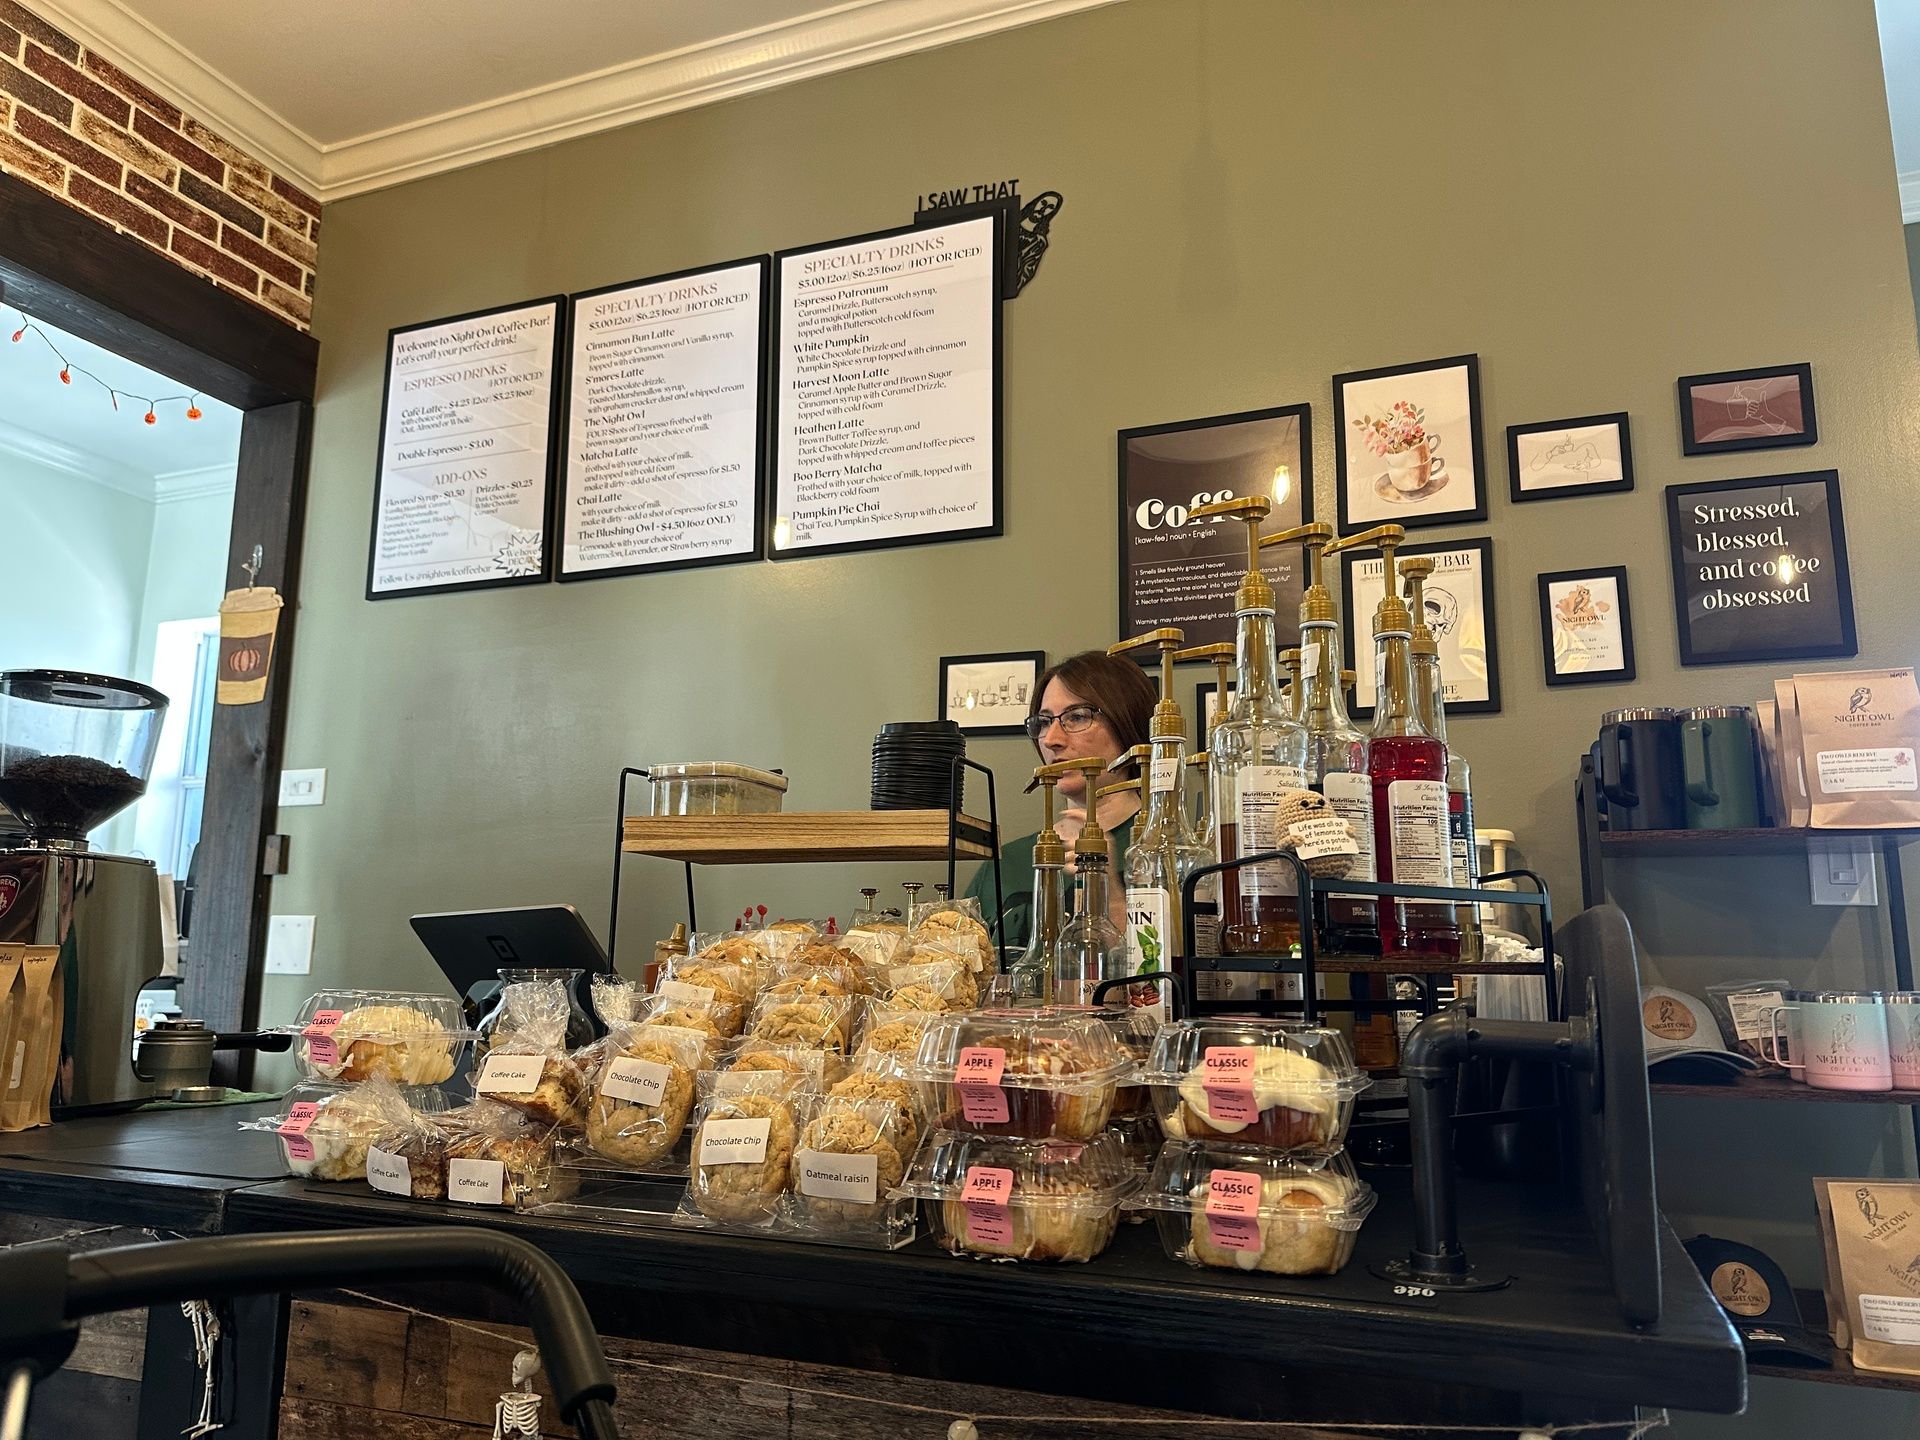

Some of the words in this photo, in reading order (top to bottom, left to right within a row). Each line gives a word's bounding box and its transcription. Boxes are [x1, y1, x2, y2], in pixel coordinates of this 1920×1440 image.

[918, 195, 922, 212] I
[928, 187, 968, 211] SAW
[972, 179, 1020, 202] THAT
[804, 249, 885, 274] SPECIALTY
[889, 236, 944, 258] DRINKS
[936, 252, 952, 263] OR
[594, 292, 666, 317] SPECIALTY
[668, 282, 717, 302] DRINKS
[794, 294, 836, 308] Espresso
[838, 284, 888, 300] Patronum
[798, 304, 831, 318] Caramel
[861, 290, 911, 306] Butterscotch
[397, 339, 438, 354] Welcome
[439, 337, 449, 345] to
[450, 330, 475, 344] Night
[476, 325, 496, 338] Owl
[496, 320, 528, 334] Coffee
[529, 315, 550, 328] Bar!
[585, 337, 630, 351] Cinnamon
[631, 334, 650, 343] Bun
[651, 328, 675, 340] Latte
[437, 347, 458, 359] your
[458, 340, 490, 356] perfect
[793, 342, 823, 353] White
[825, 333, 869, 354] Pumpkin
[404, 371, 462, 392] ESPRESSO
[463, 363, 507, 381] DRINKS
[620, 368, 644, 378] Latte
[792, 376, 830, 390] Harvest
[832, 372, 860, 383] Moon
[862, 368, 889, 379] Latte
[583, 417, 600, 428] The
[602, 413, 625, 425] Night
[626, 409, 645, 421] Owl
[794, 422, 836, 435] Heathen
[838, 418, 864, 429] Latte
[427, 445, 463, 456] Espresso
[580, 449, 613, 462] Matcha
[614, 446, 638, 457] Latte
[793, 472, 813, 482] Boo
[814, 469, 840, 479] Berry
[844, 462, 882, 474] Matcha
[576, 494, 597, 506] Chai
[598, 493, 622, 503] Latte
[796, 491, 839, 502] Blackberry
[839, 487, 857, 497] cold
[858, 486, 880, 495] foam
[792, 507, 837, 520] Pumpkin
[838, 504, 854, 515] Pie
[856, 501, 880, 512] Chai
[1136, 489, 1272, 530] Coff
[1694, 496, 1800, 524] Stressed,
[577, 530, 595, 540] The
[596, 526, 634, 538] Blushing
[635, 521, 654, 533] Owl
[1192, 528, 1216, 539] English
[1696, 526, 1789, 552] blessed,
[1444, 554, 1470, 568] BAR
[1139, 568, 1156, 576] Smells
[1185, 563, 1205, 572] ground
[1700, 558, 1744, 581] and
[1134, 588, 1164, 596] transforms
[1207, 592, 1224, 600] giving
[1702, 582, 1810, 610] obsessed
[1172, 614, 1198, 622] stimulate
[1834, 714, 1866, 723] NIGHT
[1868, 713, 1894, 721] OWL
[965, 1058, 994, 1067] APPLE
[1206, 1059, 1248, 1067] CLASSIC
[490, 1071, 510, 1079] Coffee
[610, 1070, 641, 1086] Chocolate
[643, 1078, 660, 1091] Chip
[290, 1111, 314, 1119] CLASSIC
[705, 1136, 742, 1147] Chocolate
[744, 1134, 762, 1146] Chip
[371, 1167, 385, 1176] Coffee
[385, 1170, 400, 1178] Cake
[806, 1170, 842, 1182] Oatmeal
[844, 1173, 869, 1183] raisin
[458, 1178, 476, 1187] Coffee
[476, 1180, 489, 1188] Cake
[972, 1179, 1002, 1188] APPLE
[1212, 1182, 1253, 1194] CLASSIC
